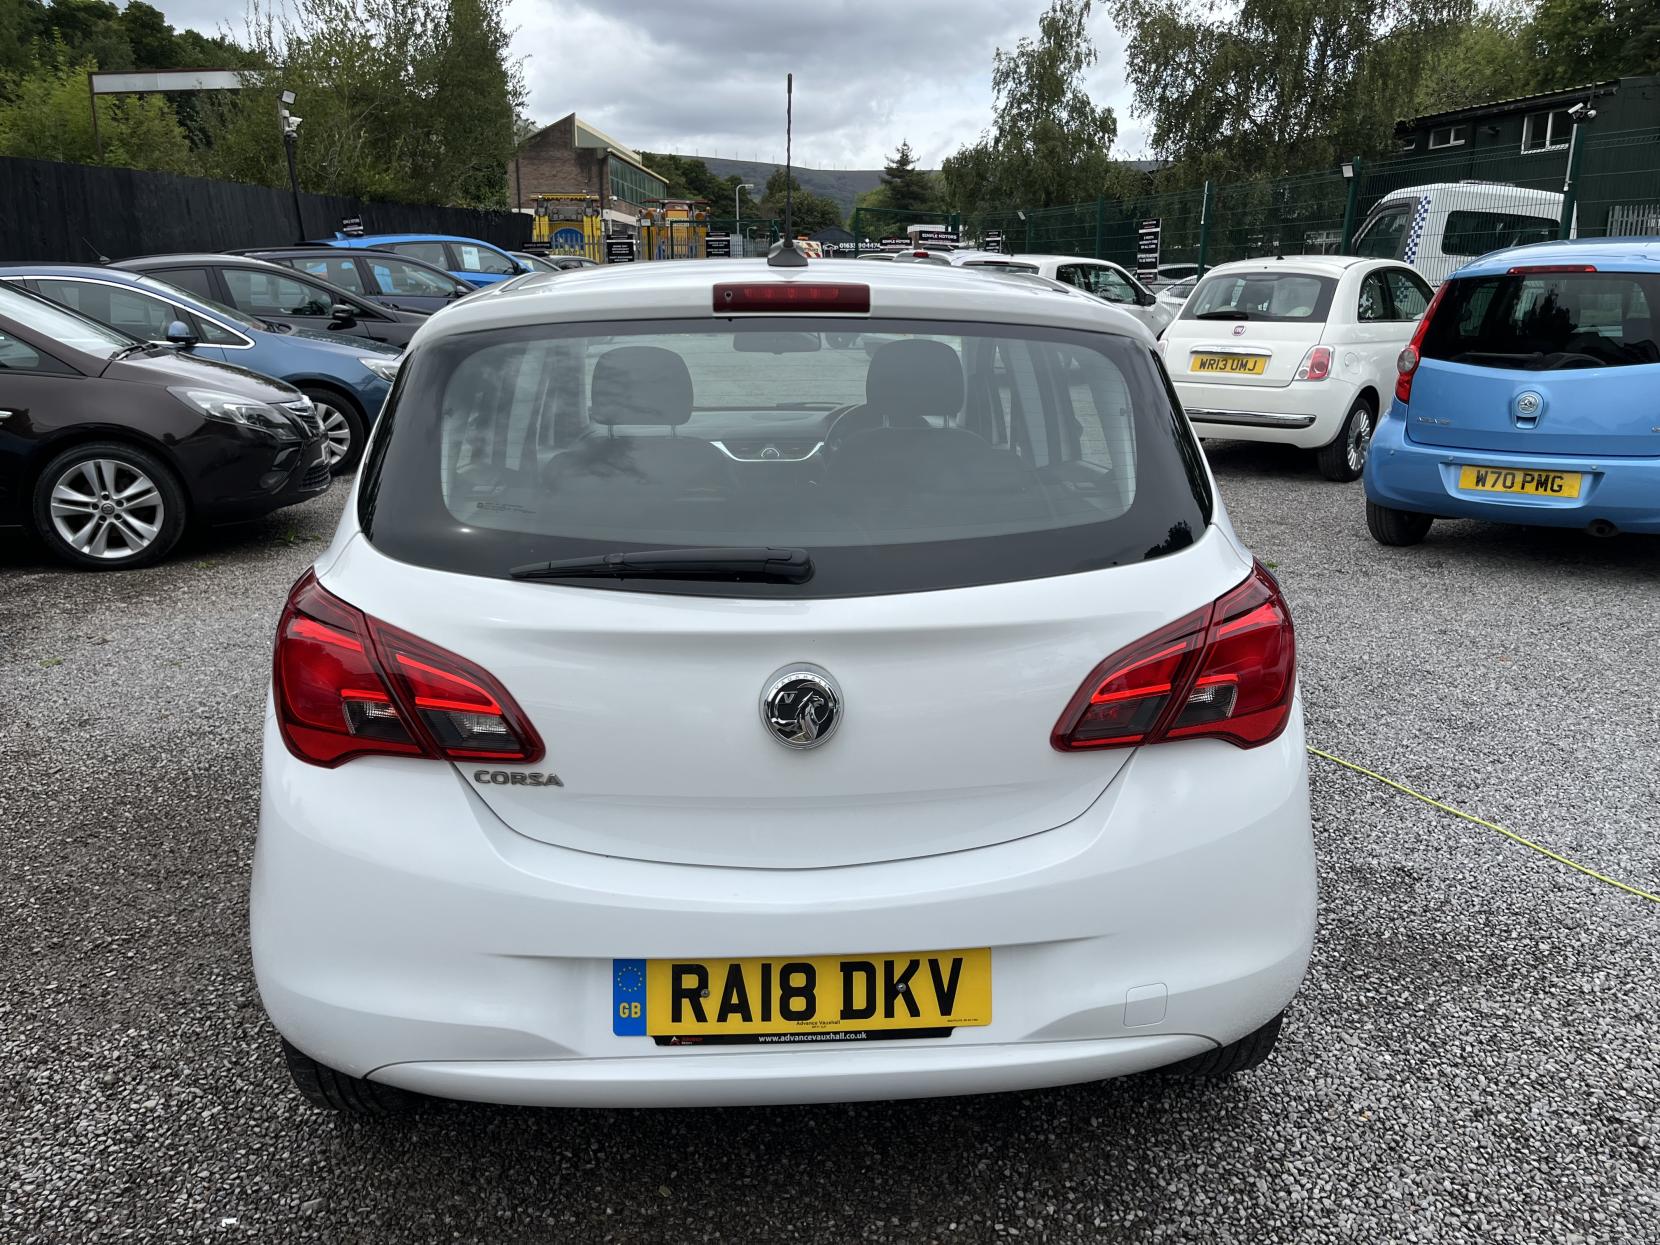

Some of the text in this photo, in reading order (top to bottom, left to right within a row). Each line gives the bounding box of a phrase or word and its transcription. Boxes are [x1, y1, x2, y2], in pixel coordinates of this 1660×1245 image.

[1199, 358, 1258, 372] WR13 UMJ
[1475, 469, 1564, 493] W70 PMG
[474, 769, 564, 787] CORSA
[671, 957, 964, 1023] RA18 DKV
[619, 1002, 642, 1018] GB
[758, 1032, 868, 1043] www.advancevauxhall.co.uk
